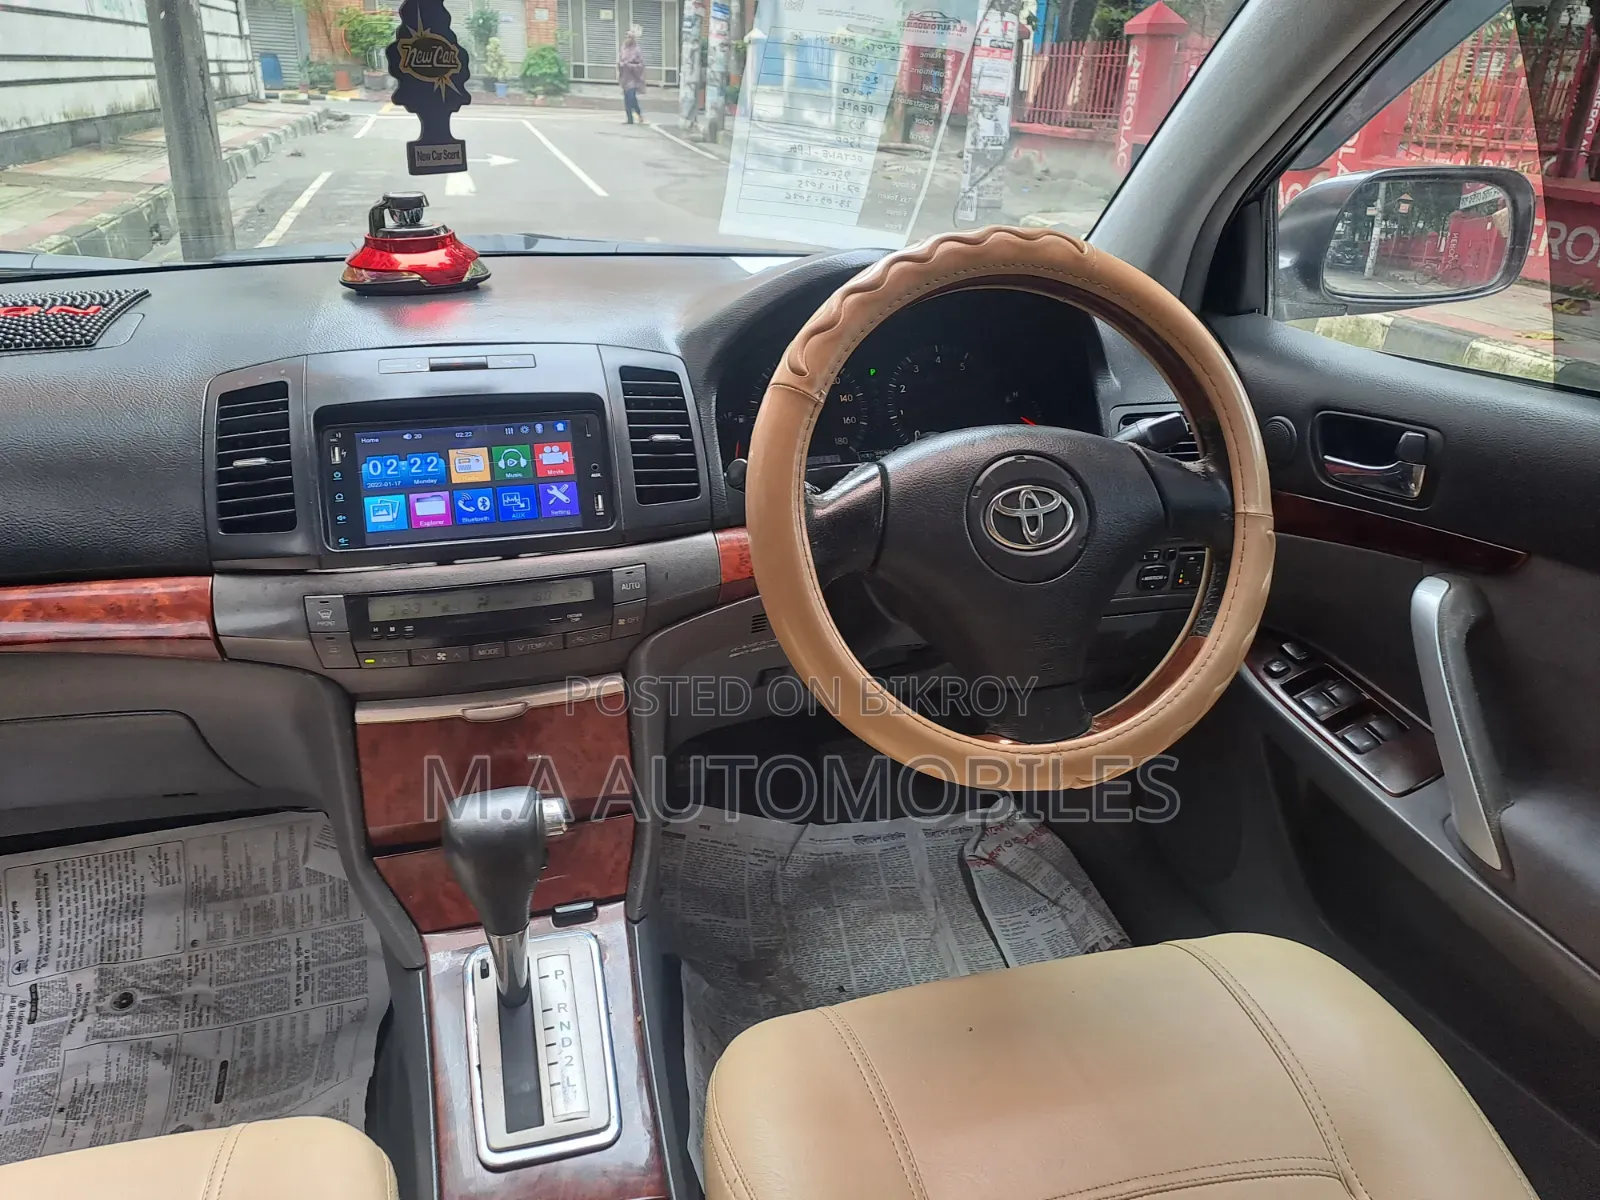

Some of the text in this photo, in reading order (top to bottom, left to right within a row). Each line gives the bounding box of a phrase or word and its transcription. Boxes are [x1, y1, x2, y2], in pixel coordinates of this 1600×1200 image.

[402, 44, 457, 68] New Car
[1116, 60, 1142, 169] NEROLAC
[417, 148, 460, 161] New Car Scent
[935, 355, 942, 364] 4
[913, 364, 920, 373] 3
[960, 362, 966, 371] 5
[899, 384, 907, 393] 2
[839, 393, 853, 402] 140
[842, 416, 857, 425] 160
[834, 437, 849, 445] 180
[368, 456, 439, 476] 02:22
[366, 480, 402, 489] 2022-01-17
[621, 582, 641, 591] AUTO
[627, 616, 640, 624] OFF
[526, 642, 546, 651] TEMP
[478, 648, 500, 656] MODE
[554, 969, 565, 980] P
[557, 1003, 568, 1013] R
[560, 1020, 571, 1031] N
[562, 1036, 573, 1048] D
[564, 1055, 575, 1067] 2
[566, 1076, 576, 1088] L
